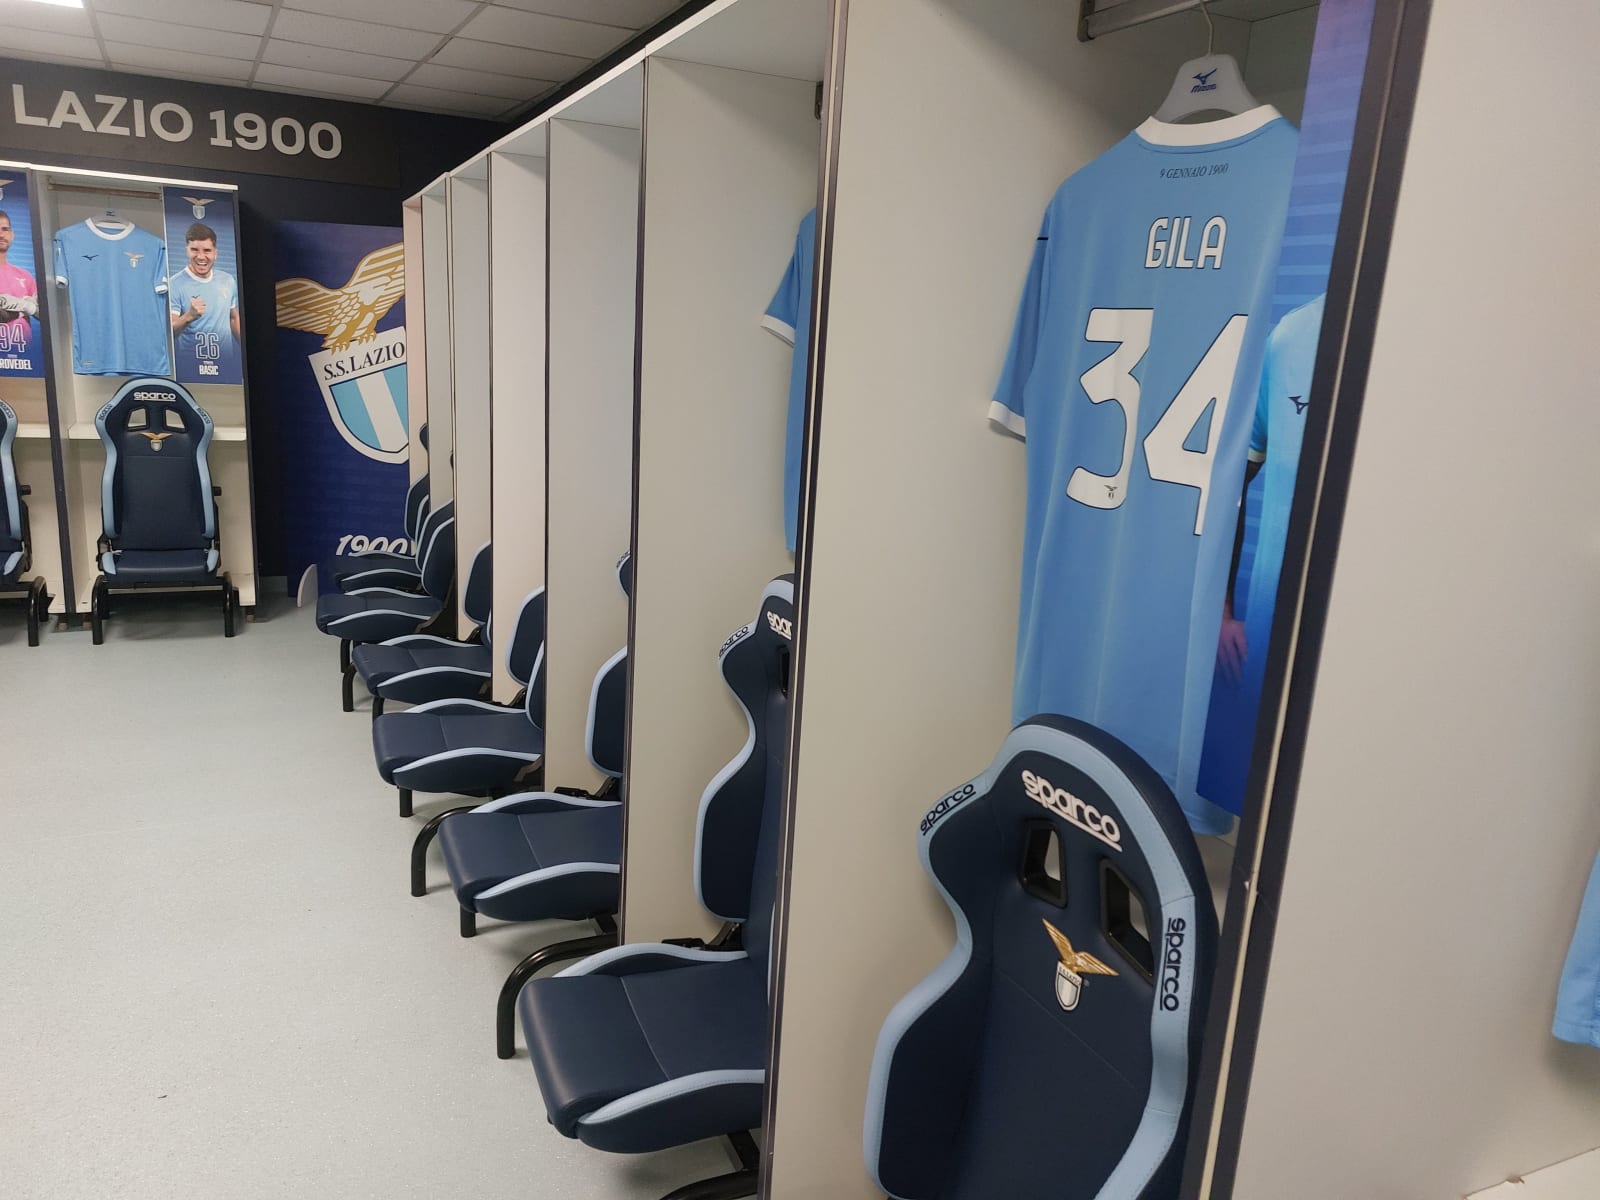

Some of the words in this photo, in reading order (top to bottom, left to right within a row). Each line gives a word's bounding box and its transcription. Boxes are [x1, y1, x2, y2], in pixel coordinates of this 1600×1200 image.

[12, 83, 194, 143] LAZIO
[209, 109, 343, 160] 1900
[1166, 165, 1207, 179] GENNAIO
[1208, 162, 1230, 176] 1900
[1144, 215, 1228, 269] GILA
[0, 322, 27, 353] 94
[195, 331, 220, 360] 26
[133, 391, 176, 402] sparco
[199, 364, 219, 376] BASIC
[1066, 307, 1249, 536] 34
[920, 783, 977, 836] sparco
[1021, 769, 1122, 852] sparco
[1159, 916, 1186, 1012] sparco
